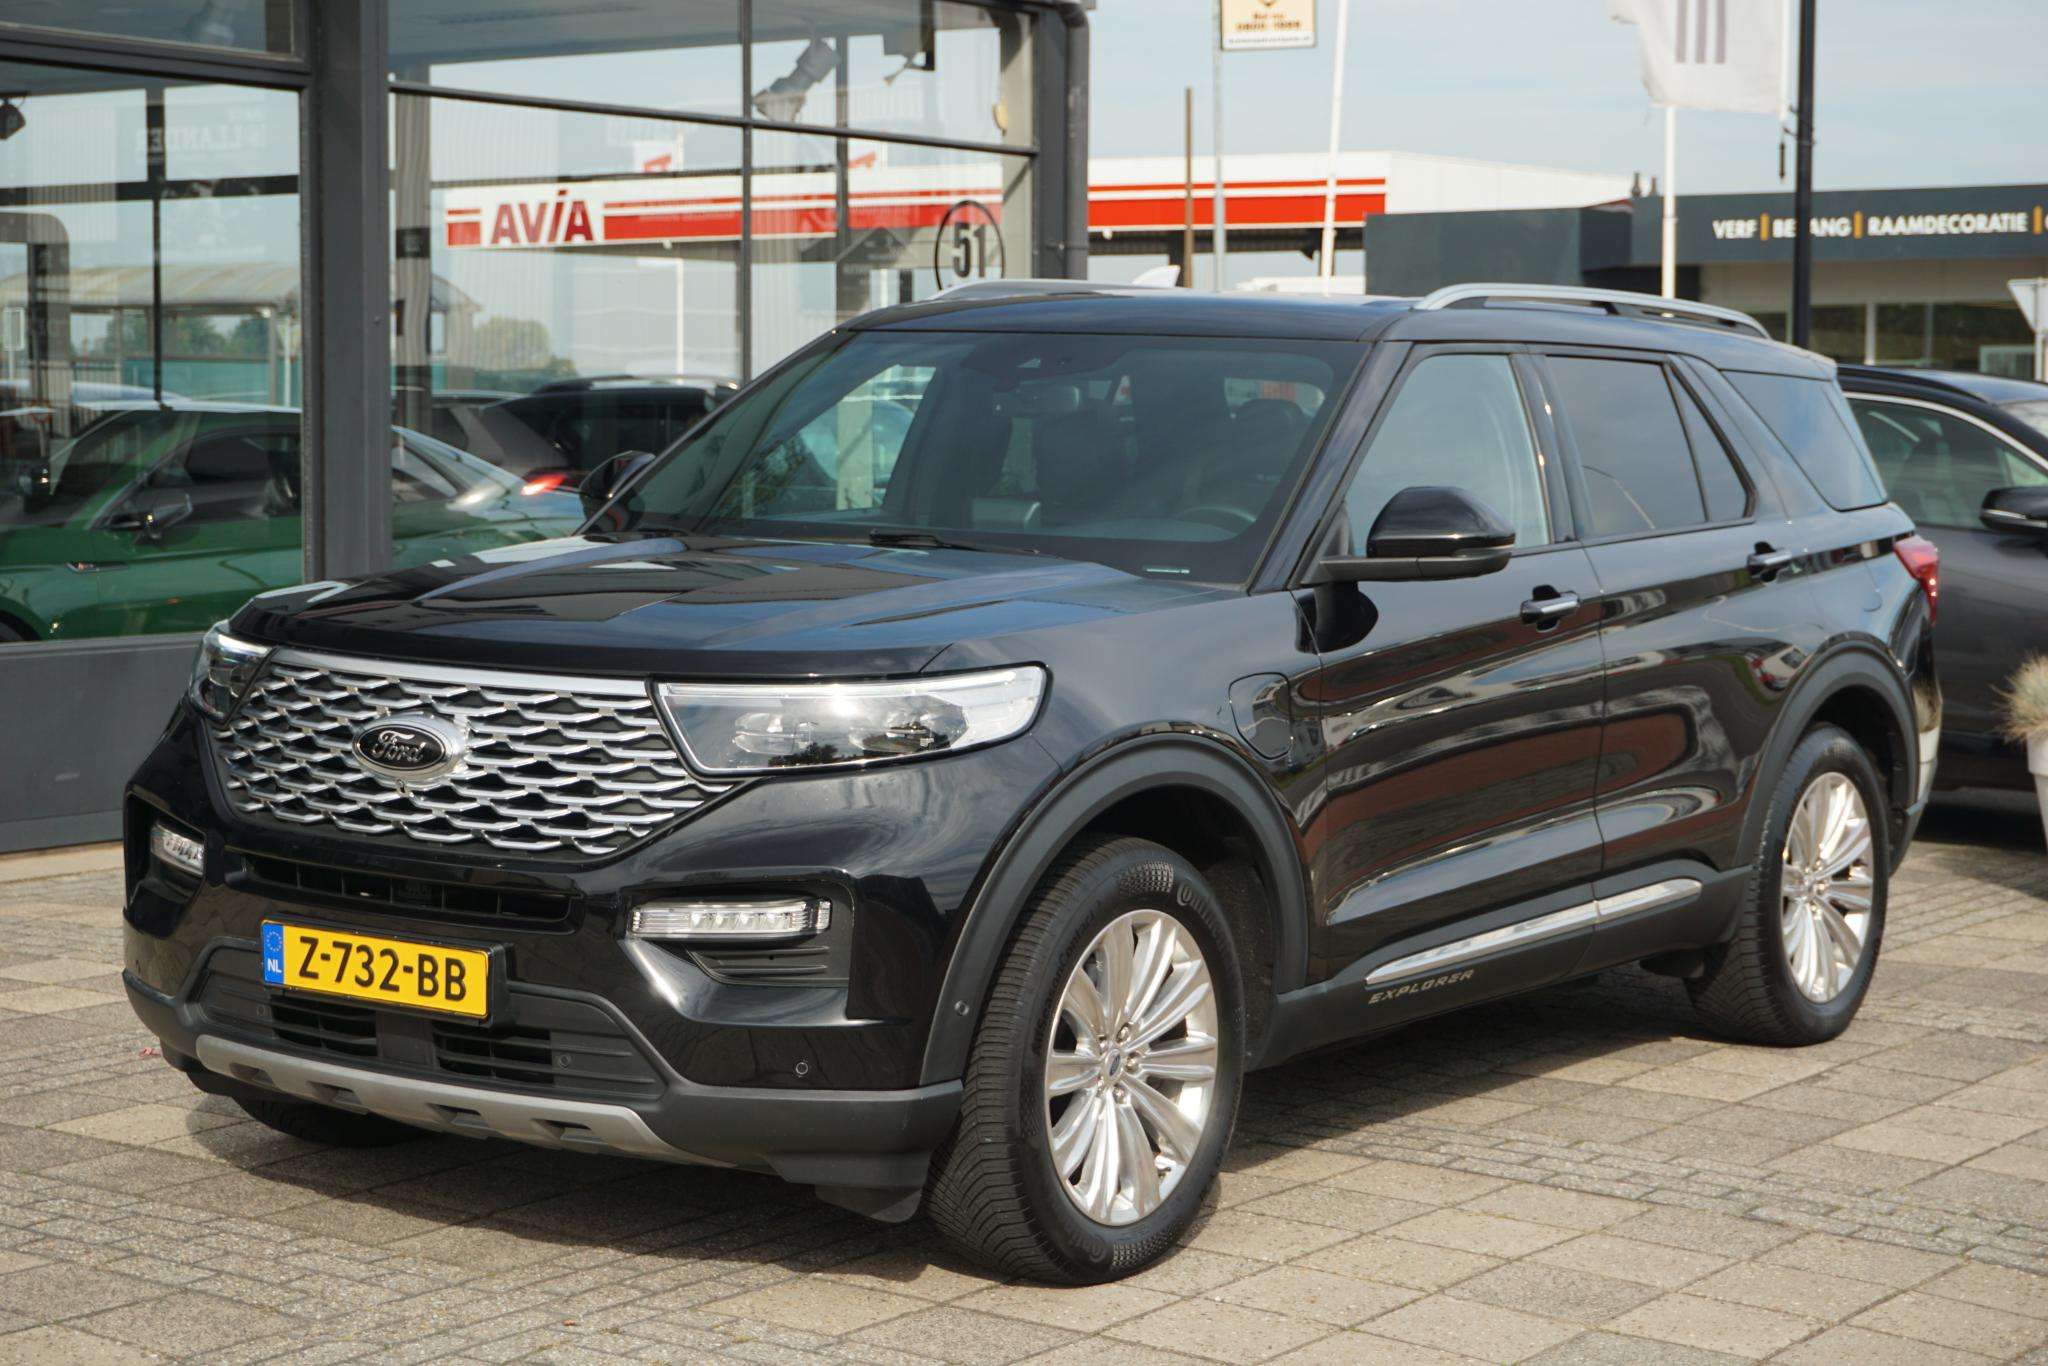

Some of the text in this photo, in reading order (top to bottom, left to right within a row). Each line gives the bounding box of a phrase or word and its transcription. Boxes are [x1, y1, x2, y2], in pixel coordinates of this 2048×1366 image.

[1712, 212, 2028, 239] VERF BEANG RAAMDECORATIE
[953, 221, 987, 278] 51
[371, 730, 427, 763] Ford
[267, 958, 282, 974] NL
[299, 936, 467, 1002] Z-732-BB
[1368, 968, 1475, 1005] EXPLORER
